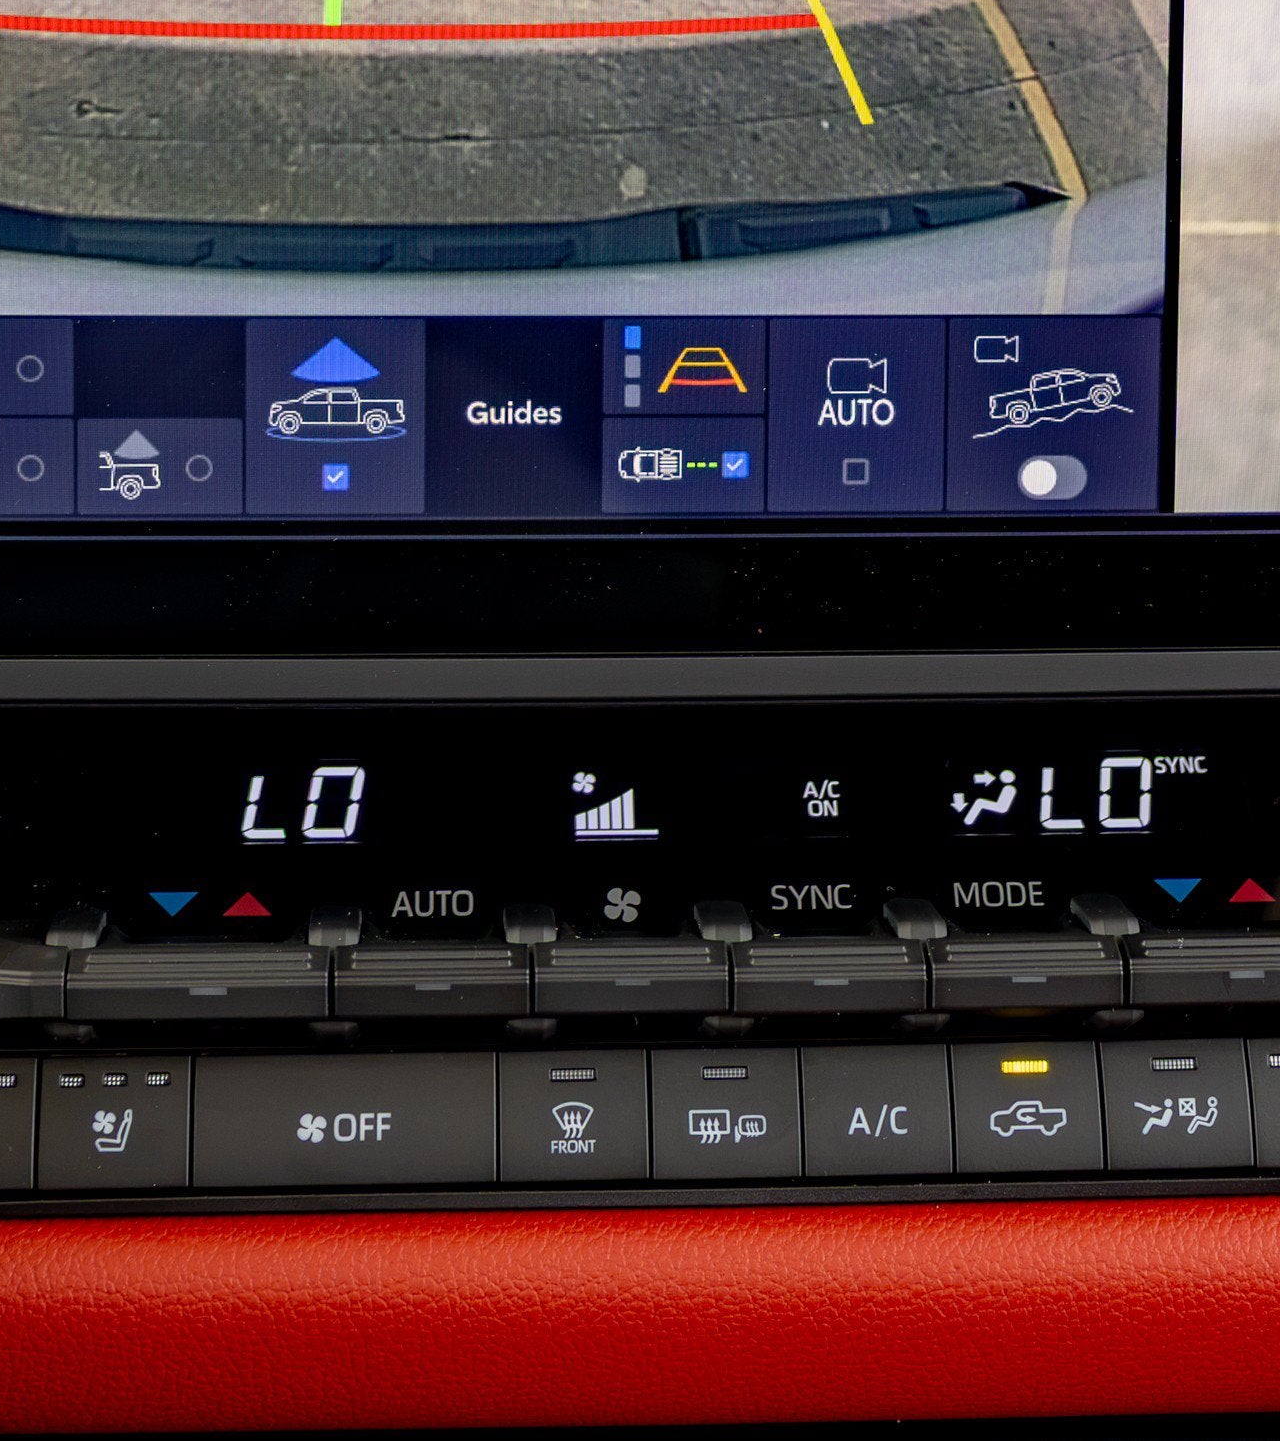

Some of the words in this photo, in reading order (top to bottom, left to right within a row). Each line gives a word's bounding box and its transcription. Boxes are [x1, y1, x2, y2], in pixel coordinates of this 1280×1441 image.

[466, 400, 562, 425] Guides
[818, 399, 895, 426] AUTO
[1153, 755, 1208, 774] SYNC
[802, 779, 841, 799] A/C
[1039, 757, 1152, 829] LO
[241, 766, 366, 840] LO
[807, 799, 839, 817] ON
[391, 889, 474, 918] AUTO
[770, 883, 853, 910] SYNC
[953, 881, 1045, 908] MODE
[333, 1112, 392, 1142] OFF
[848, 1104, 908, 1137] A/C
[550, 1139, 597, 1154] FRONT
